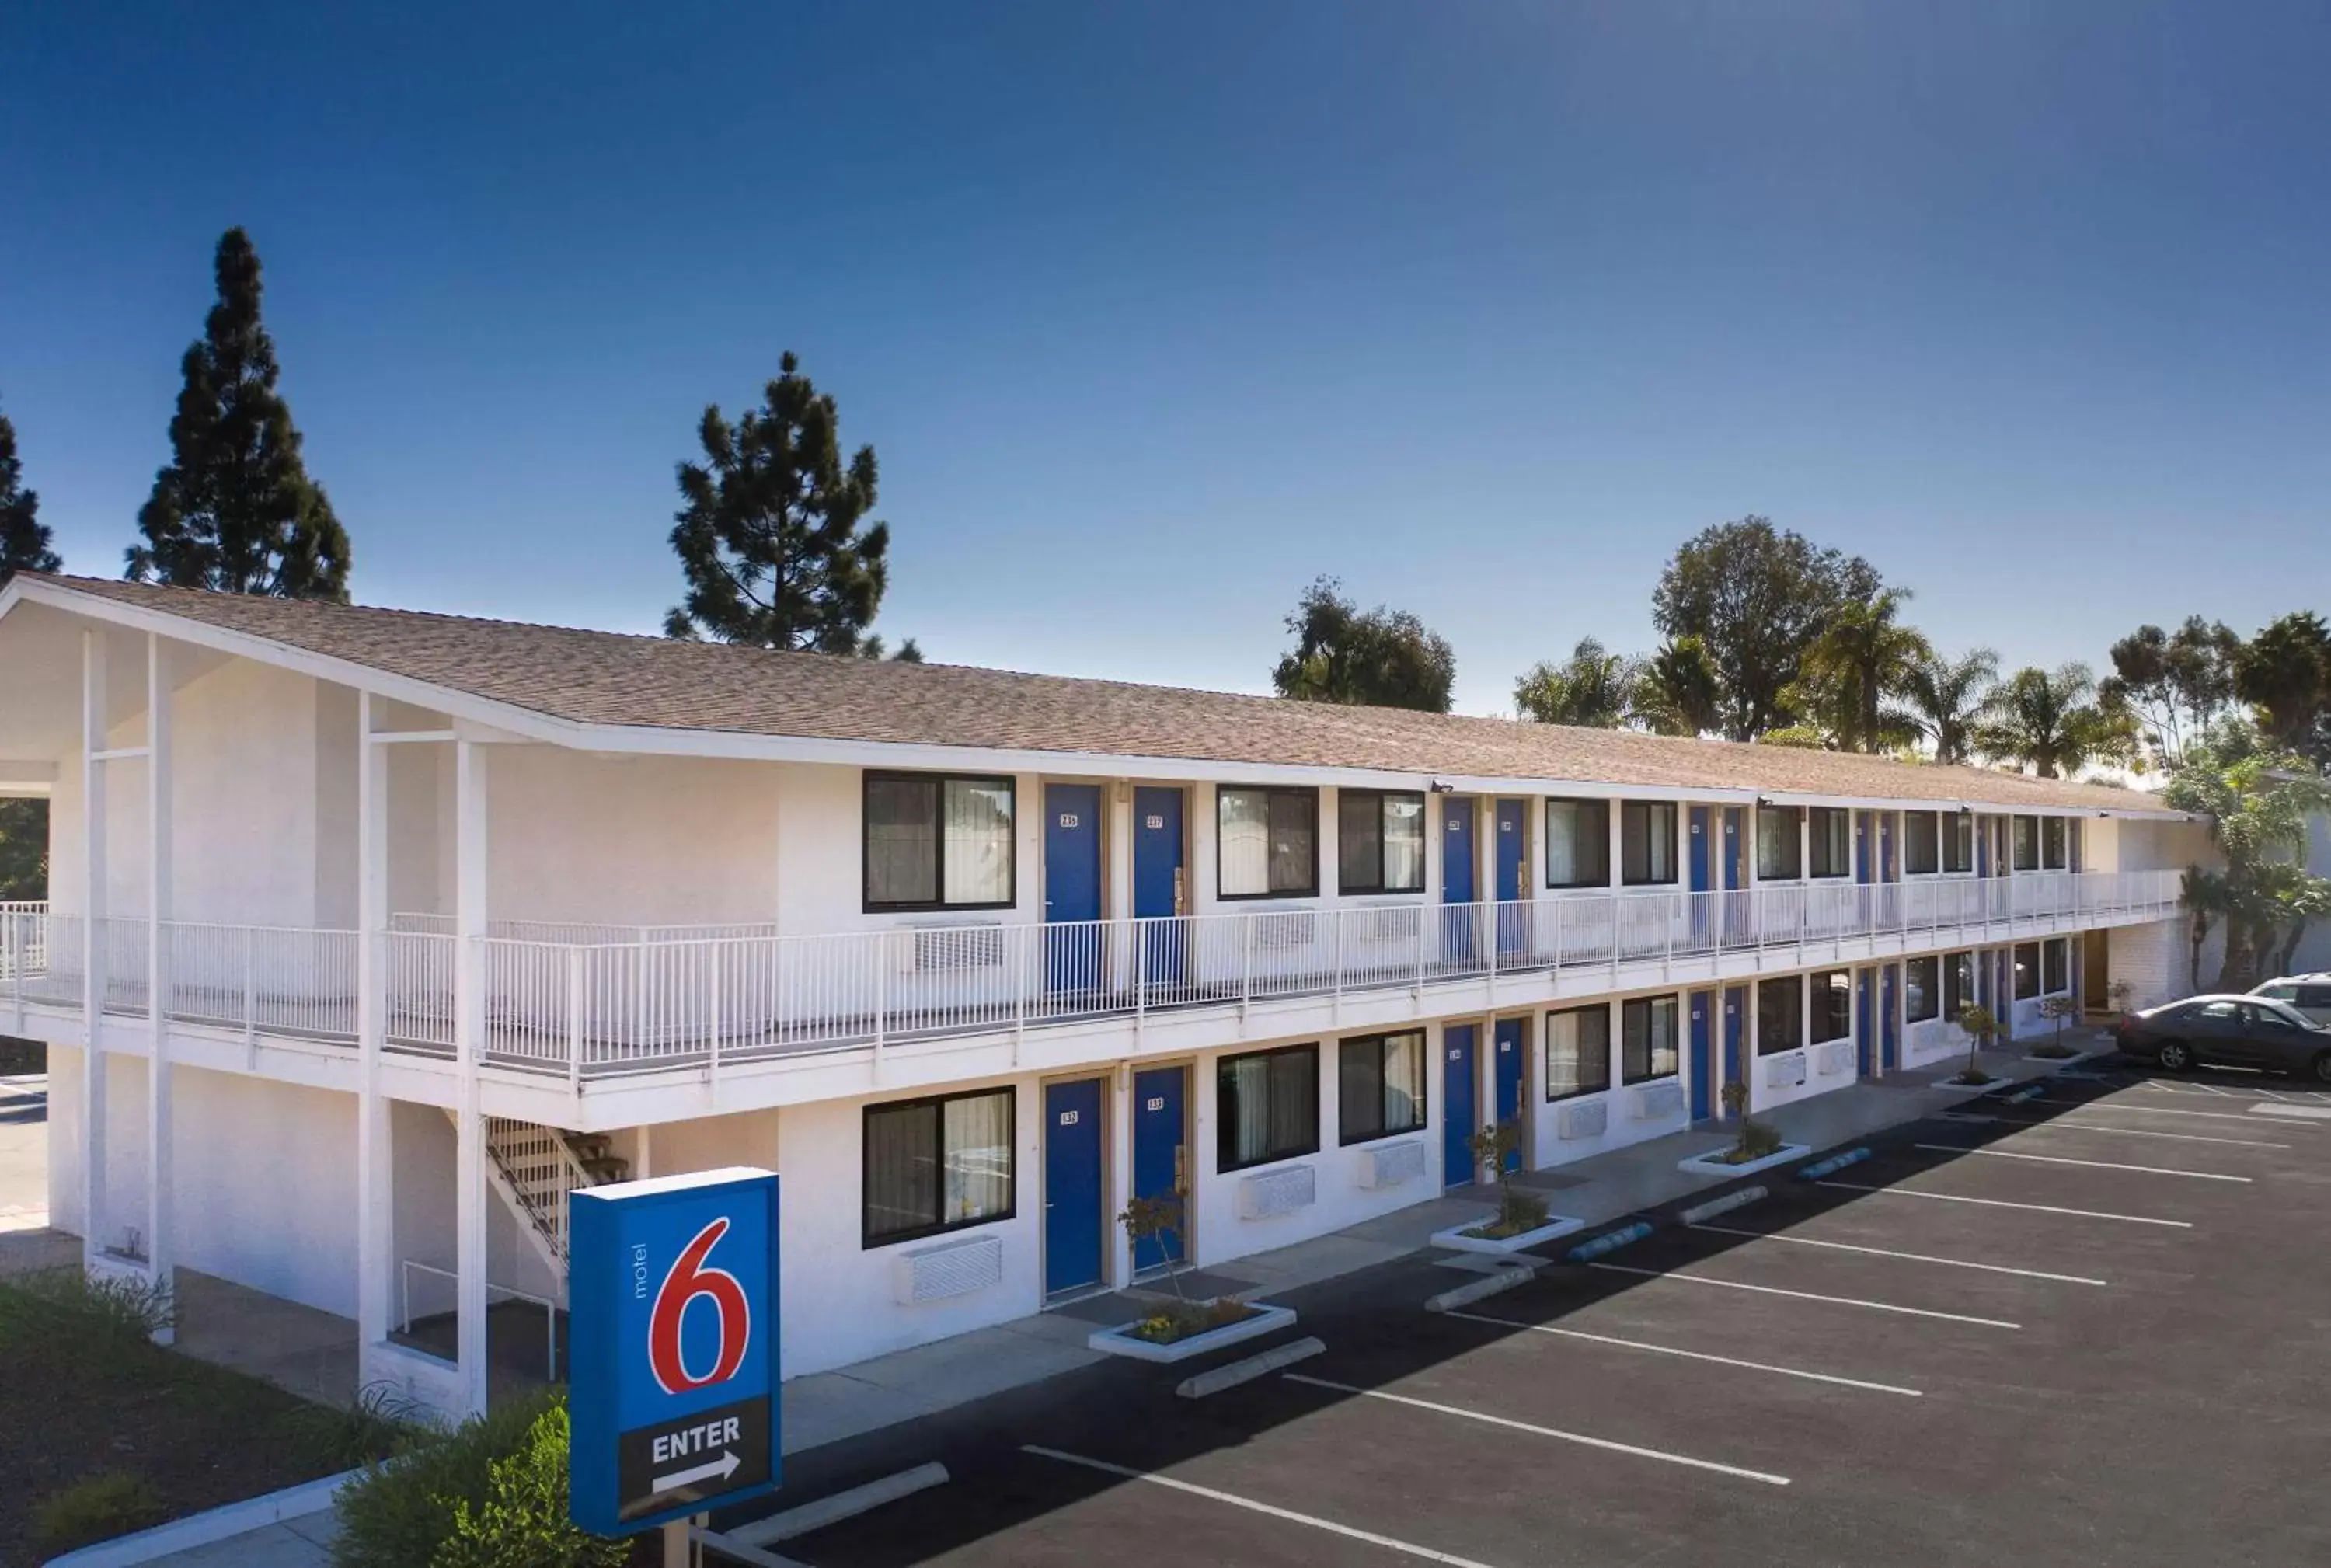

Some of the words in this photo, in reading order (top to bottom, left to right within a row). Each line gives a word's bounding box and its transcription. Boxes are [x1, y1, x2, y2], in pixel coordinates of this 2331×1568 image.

[631, 1243, 647, 1299] motel
[648, 1216, 751, 1395] 6
[652, 1416, 740, 1463] ENTER
